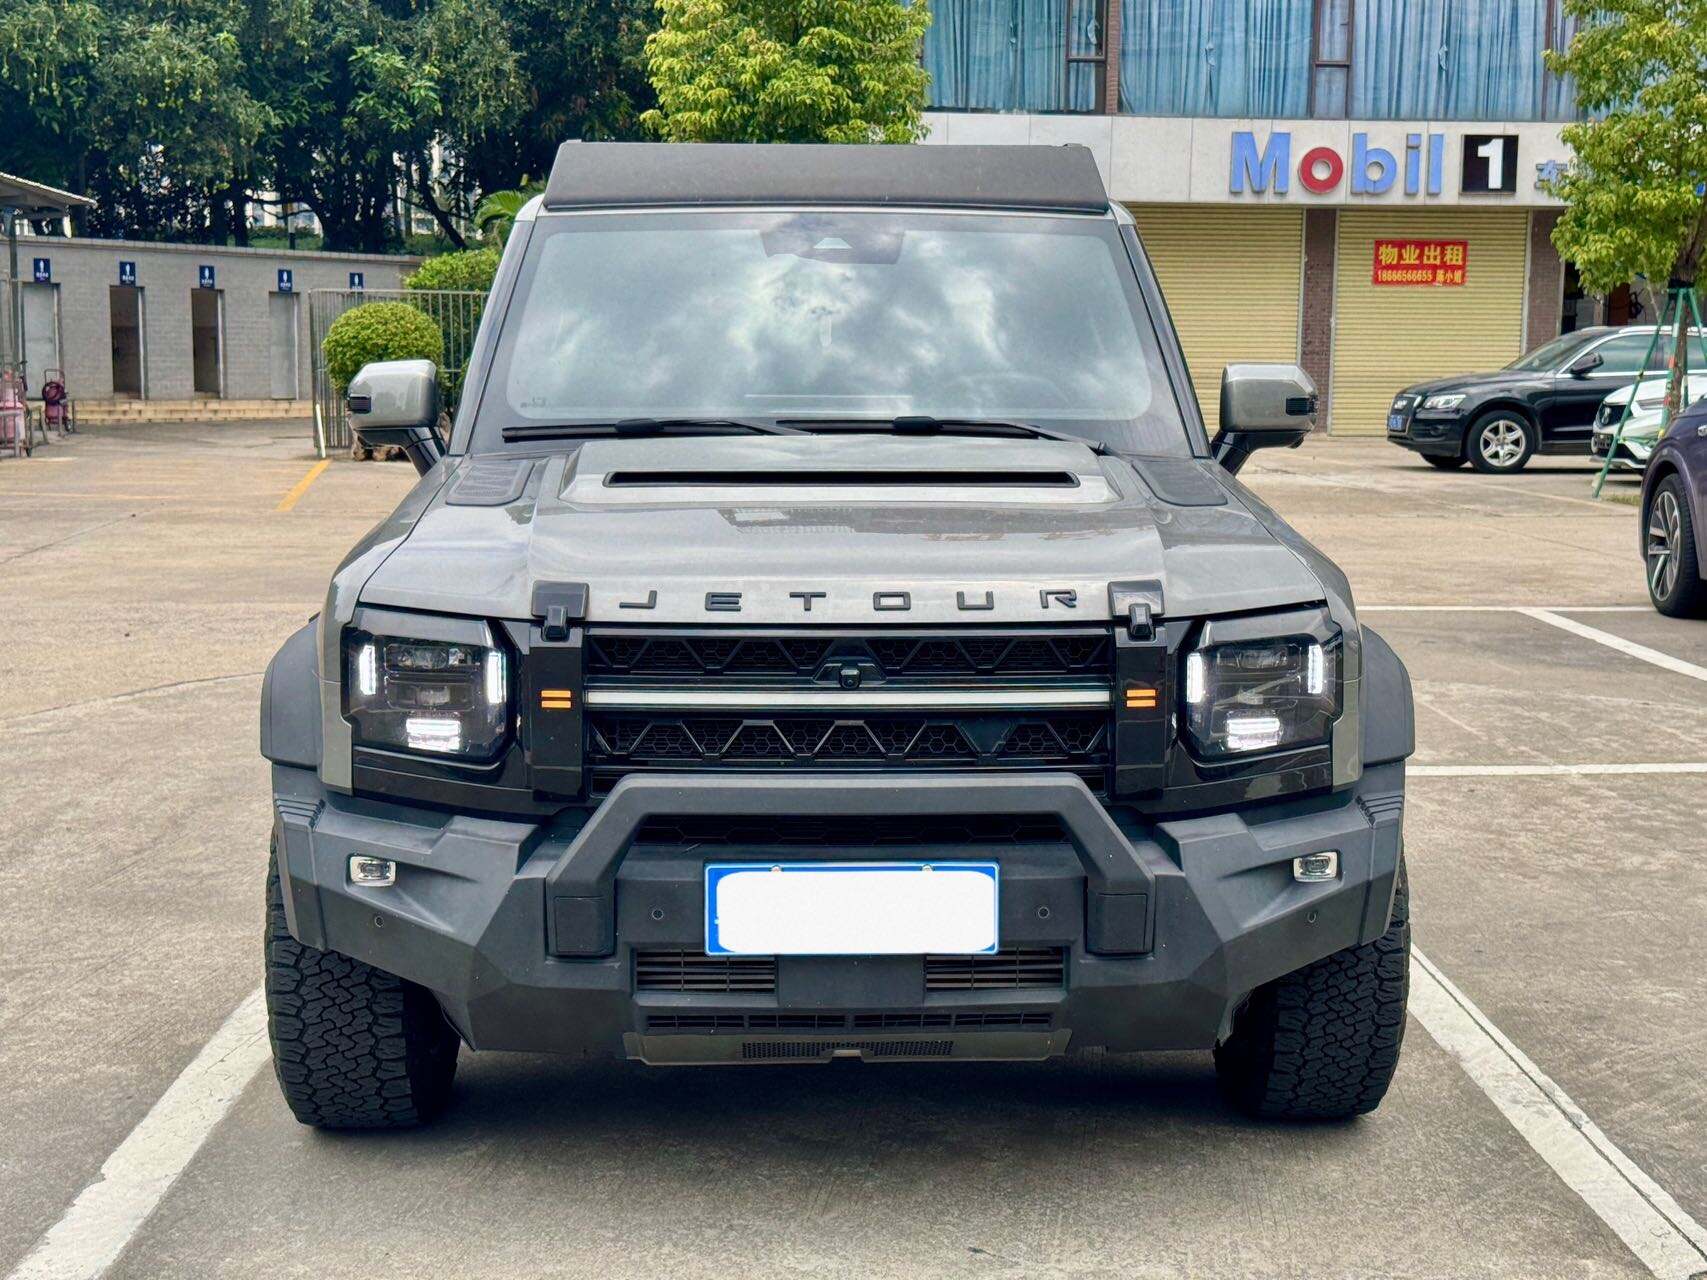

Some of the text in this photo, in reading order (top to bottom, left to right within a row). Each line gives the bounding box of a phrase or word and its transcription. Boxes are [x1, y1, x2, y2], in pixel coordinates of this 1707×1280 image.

[1230, 132, 1445, 195] Mobil
[1477, 138, 1504, 190] 1
[1378, 244, 1463, 265] 物业出租
[619, 589, 1077, 611] JETOUR
